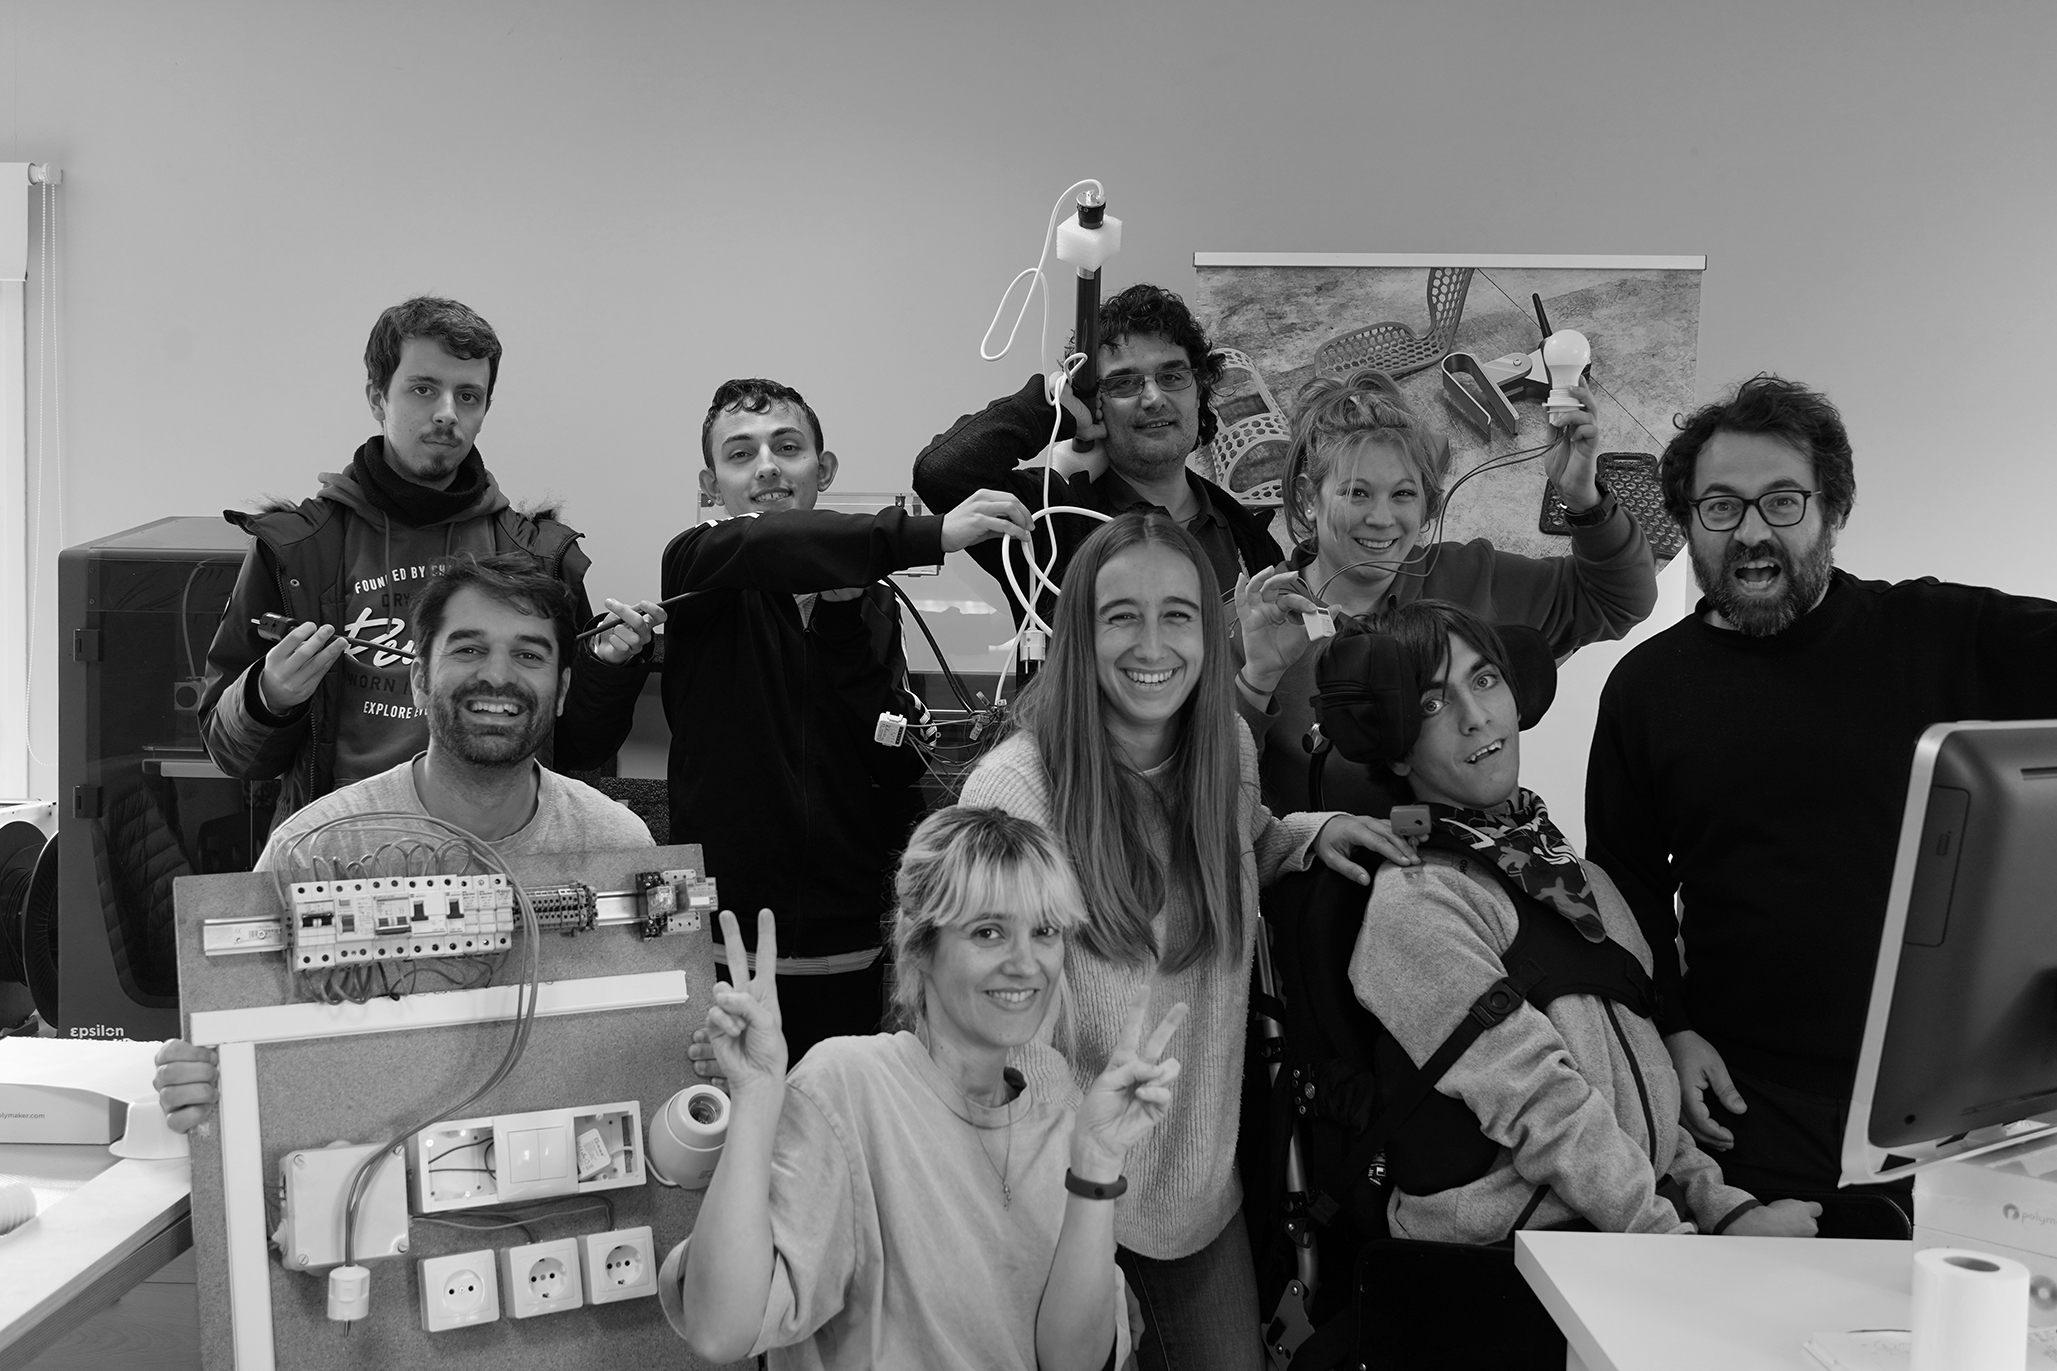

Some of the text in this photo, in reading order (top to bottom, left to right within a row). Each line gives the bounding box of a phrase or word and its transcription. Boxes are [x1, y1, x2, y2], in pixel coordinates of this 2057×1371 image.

[410, 565, 426, 579] BY
[347, 671, 396, 694] WORN
[363, 700, 413, 720] EXPLORE
